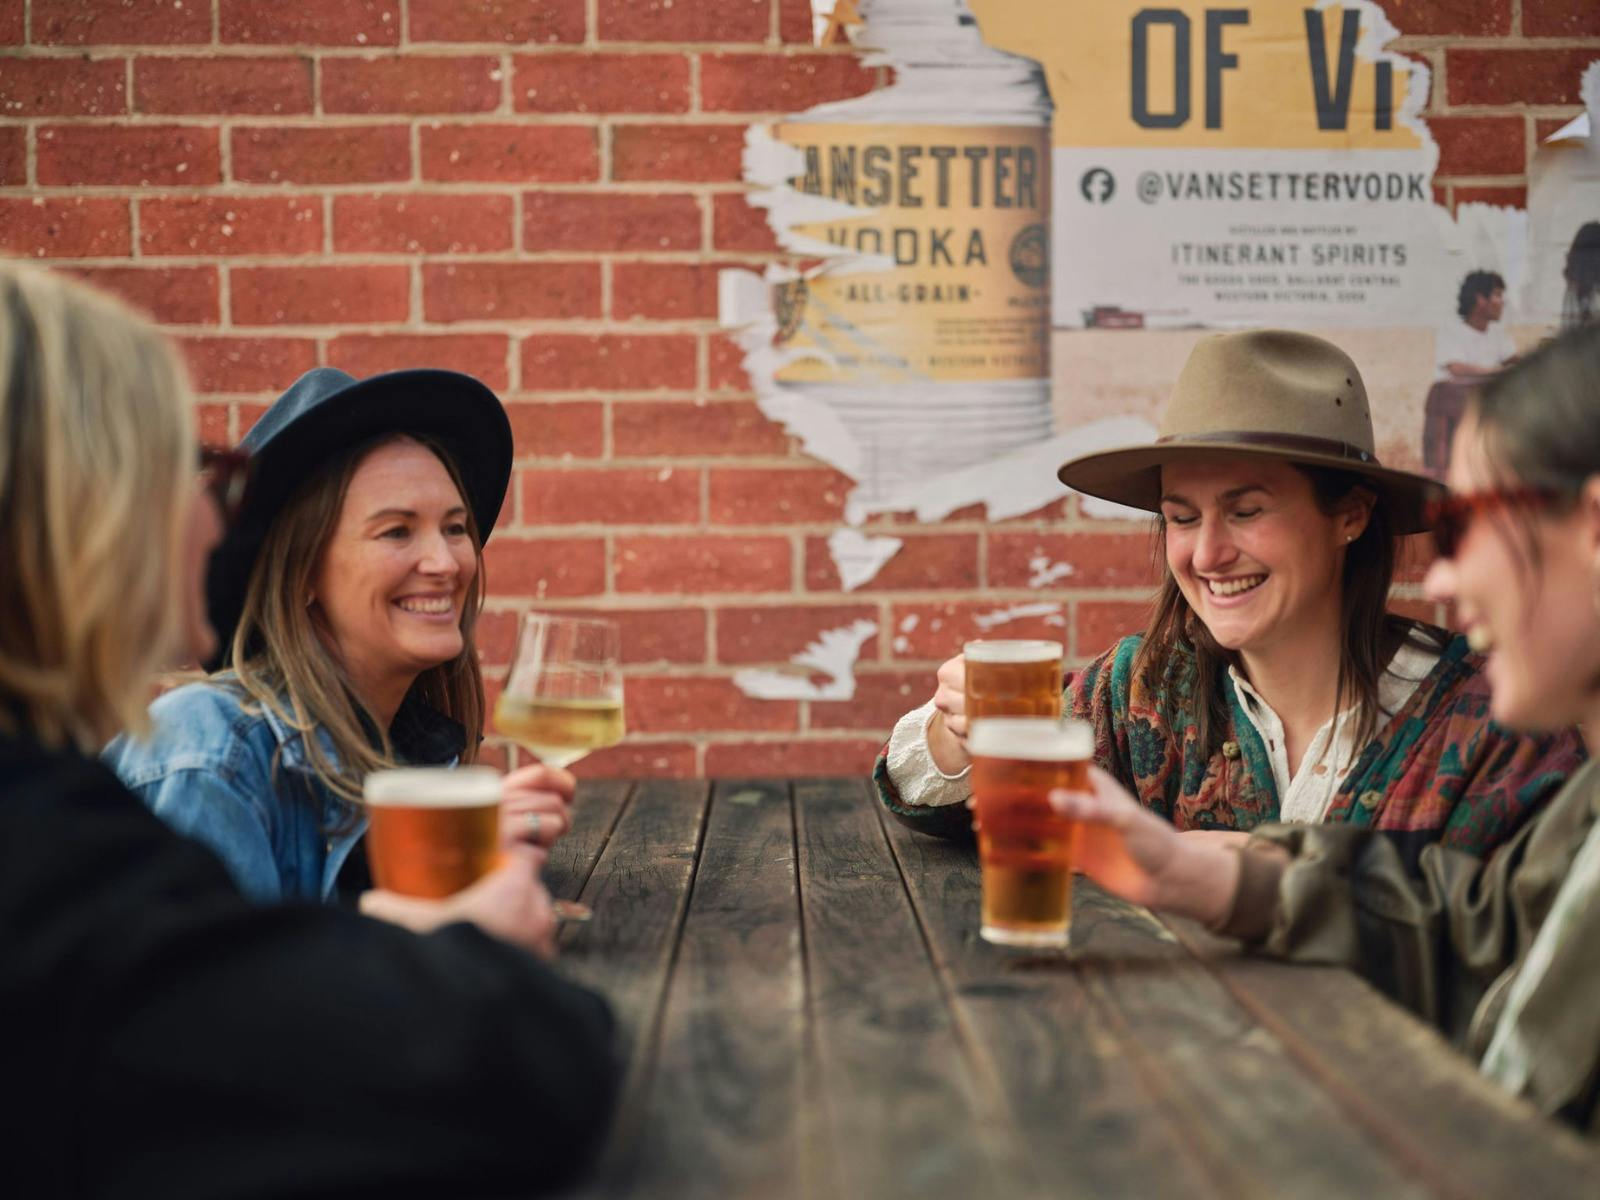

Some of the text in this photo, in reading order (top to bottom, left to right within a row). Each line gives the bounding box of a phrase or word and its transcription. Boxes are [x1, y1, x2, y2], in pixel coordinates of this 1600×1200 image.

[1131, 8, 1250, 130] OF
[787, 145, 1037, 208] ANSETTER
[1136, 172, 1425, 204] @VANSETTERVODK
[1171, 243, 1407, 266] ITINERANT SPIRITS
